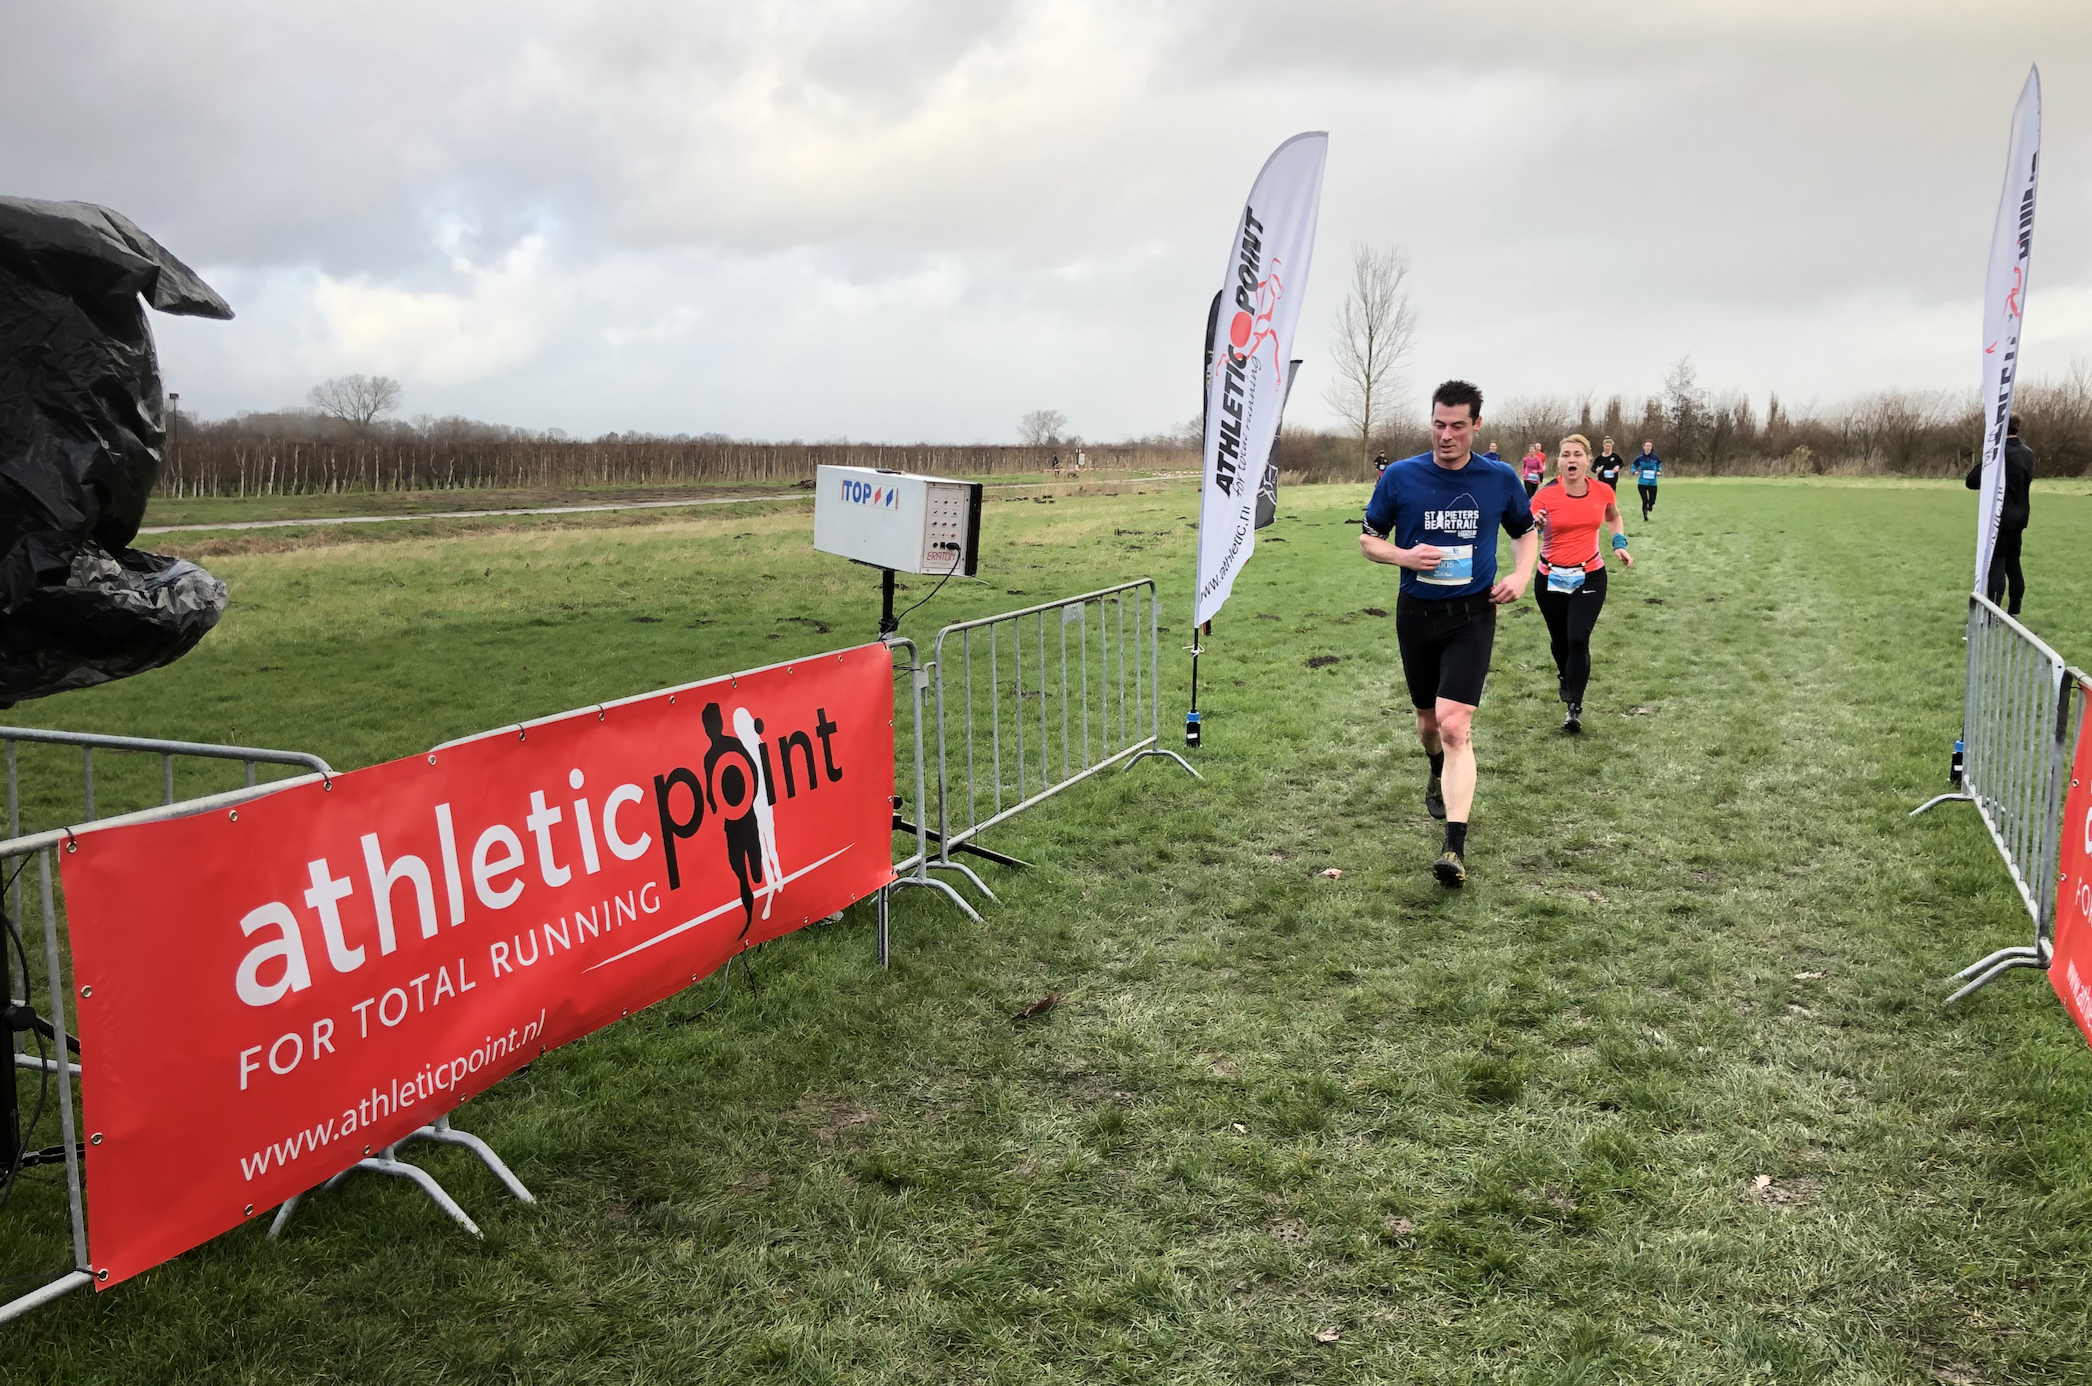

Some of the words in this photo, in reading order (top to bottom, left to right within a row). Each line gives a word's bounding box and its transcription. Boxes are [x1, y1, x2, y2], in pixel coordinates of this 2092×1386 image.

[1246, 355, 1263, 431] running
[842, 480, 872, 504] TOP
[1424, 510, 1436, 520] ST
[1444, 510, 1479, 520] PIETERS
[240, 1018, 336, 1091] FOR
[351, 958, 477, 1039] TOTAL
[490, 881, 661, 979] RUNNING
[240, 1008, 546, 1182] www.athleticpoint.nl
